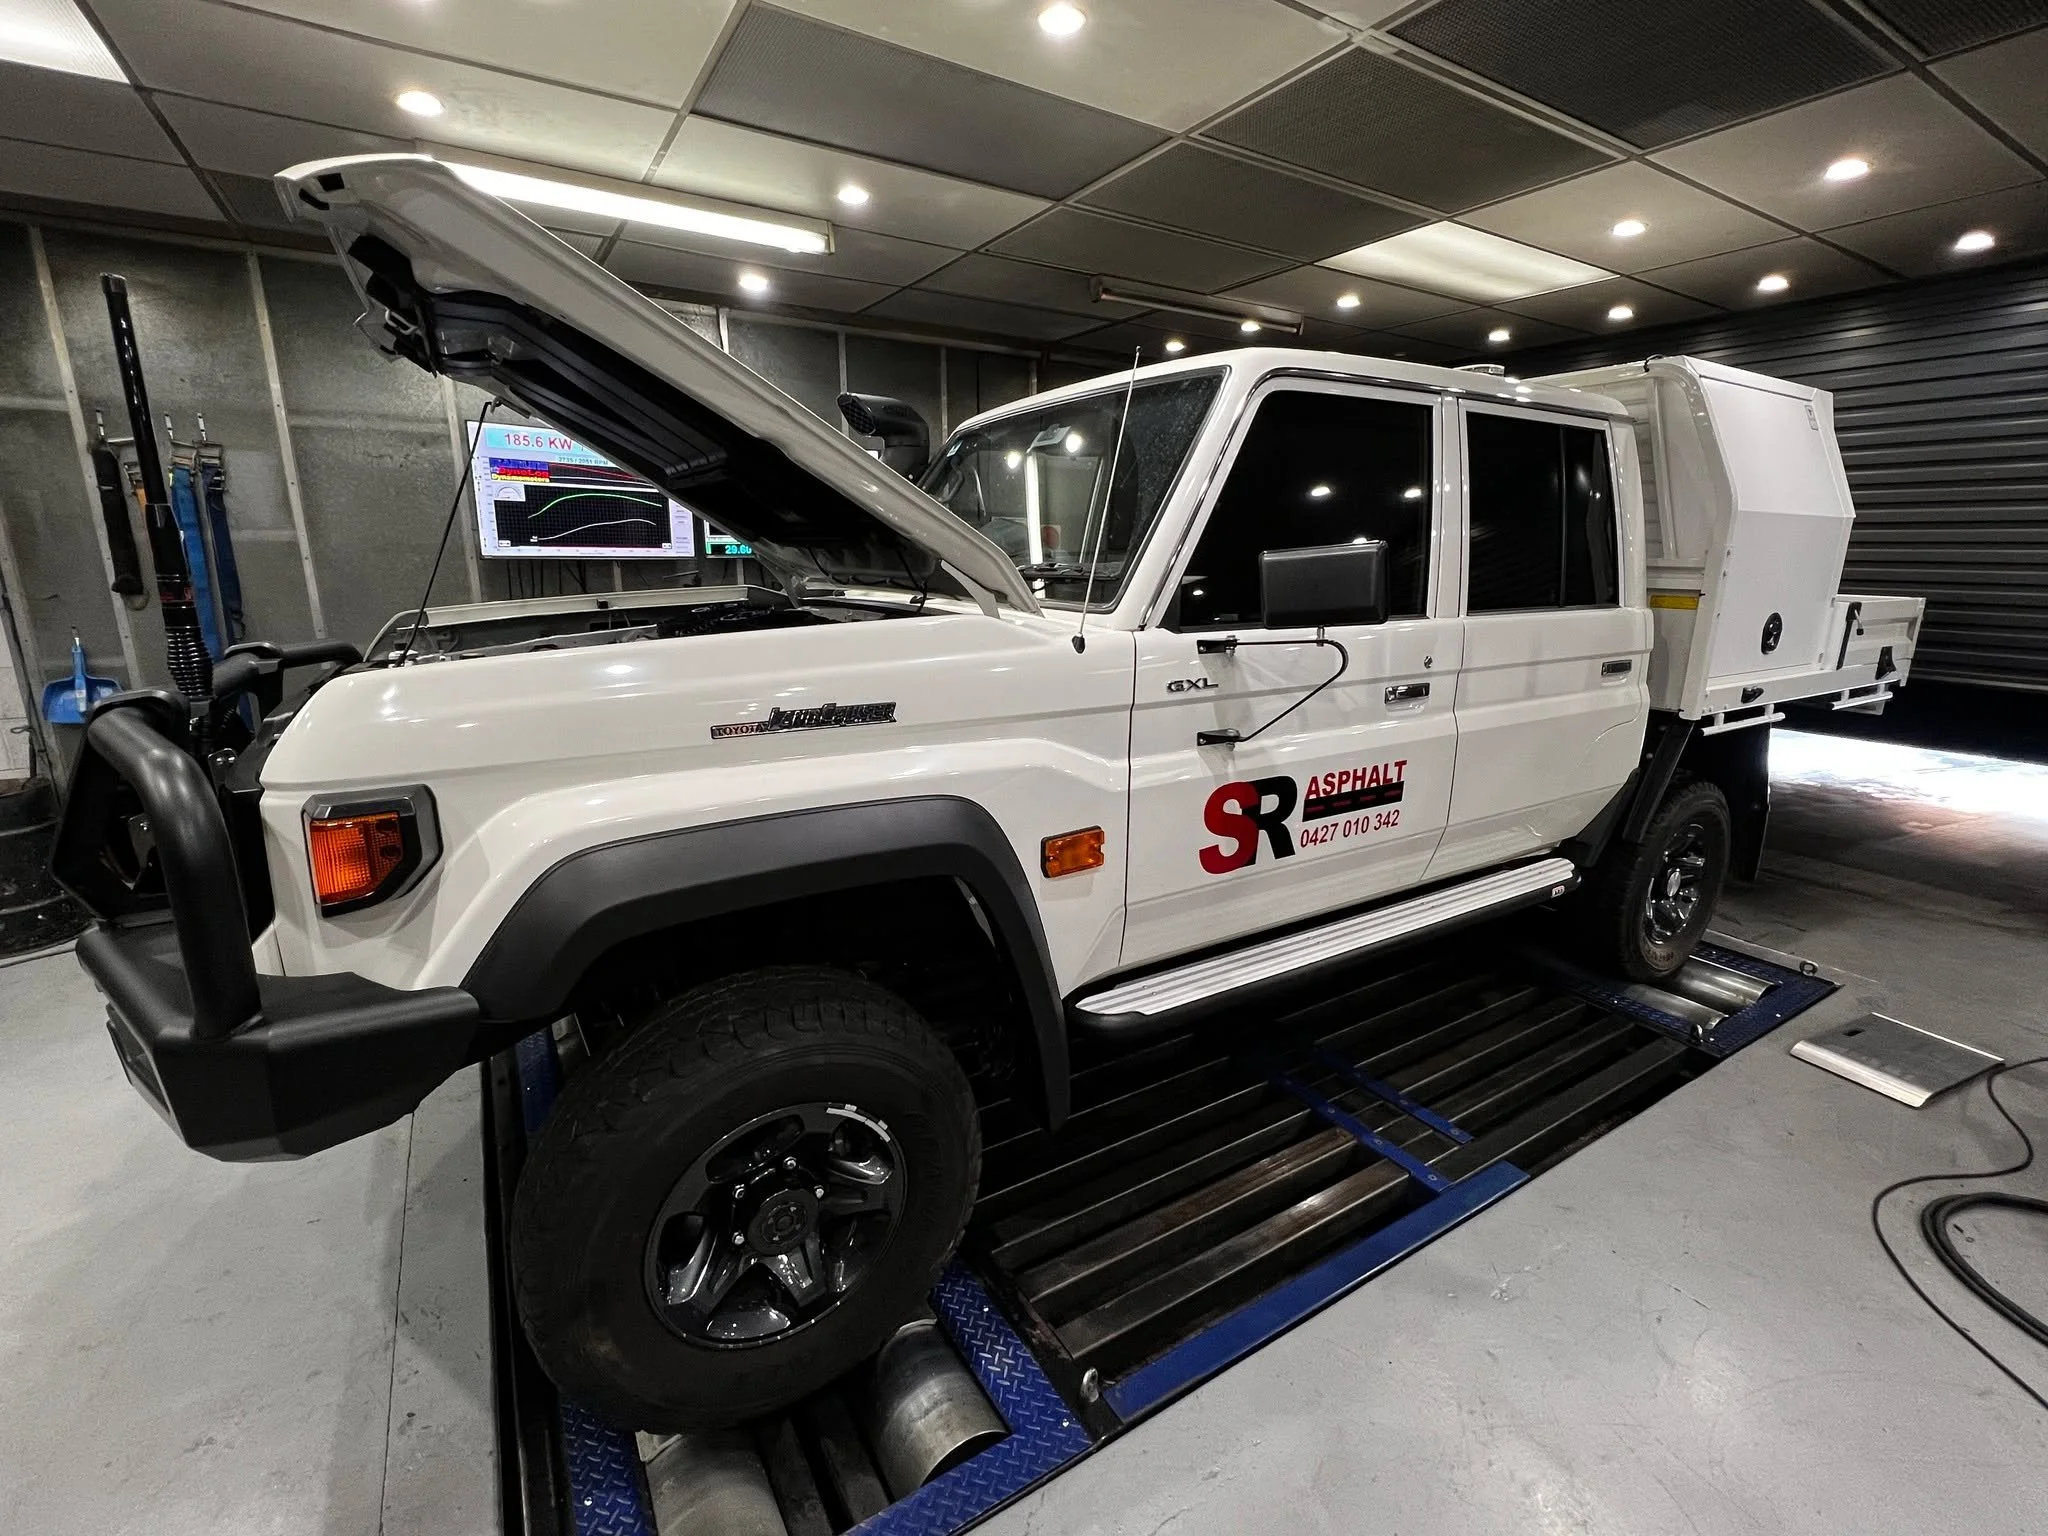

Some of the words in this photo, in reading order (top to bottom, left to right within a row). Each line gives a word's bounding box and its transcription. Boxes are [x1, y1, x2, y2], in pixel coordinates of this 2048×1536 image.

[504, 433, 543, 448] 185.6
[548, 437, 572, 450] KW
[1167, 677, 1219, 693] GXL
[716, 723, 765, 737] TOYOTA
[1304, 759, 1408, 801] ASPHALT
[1199, 775, 1298, 875] SR
[1300, 822, 1339, 849] 0427
[1343, 815, 1370, 839] 010
[1373, 808, 1400, 832] 342
